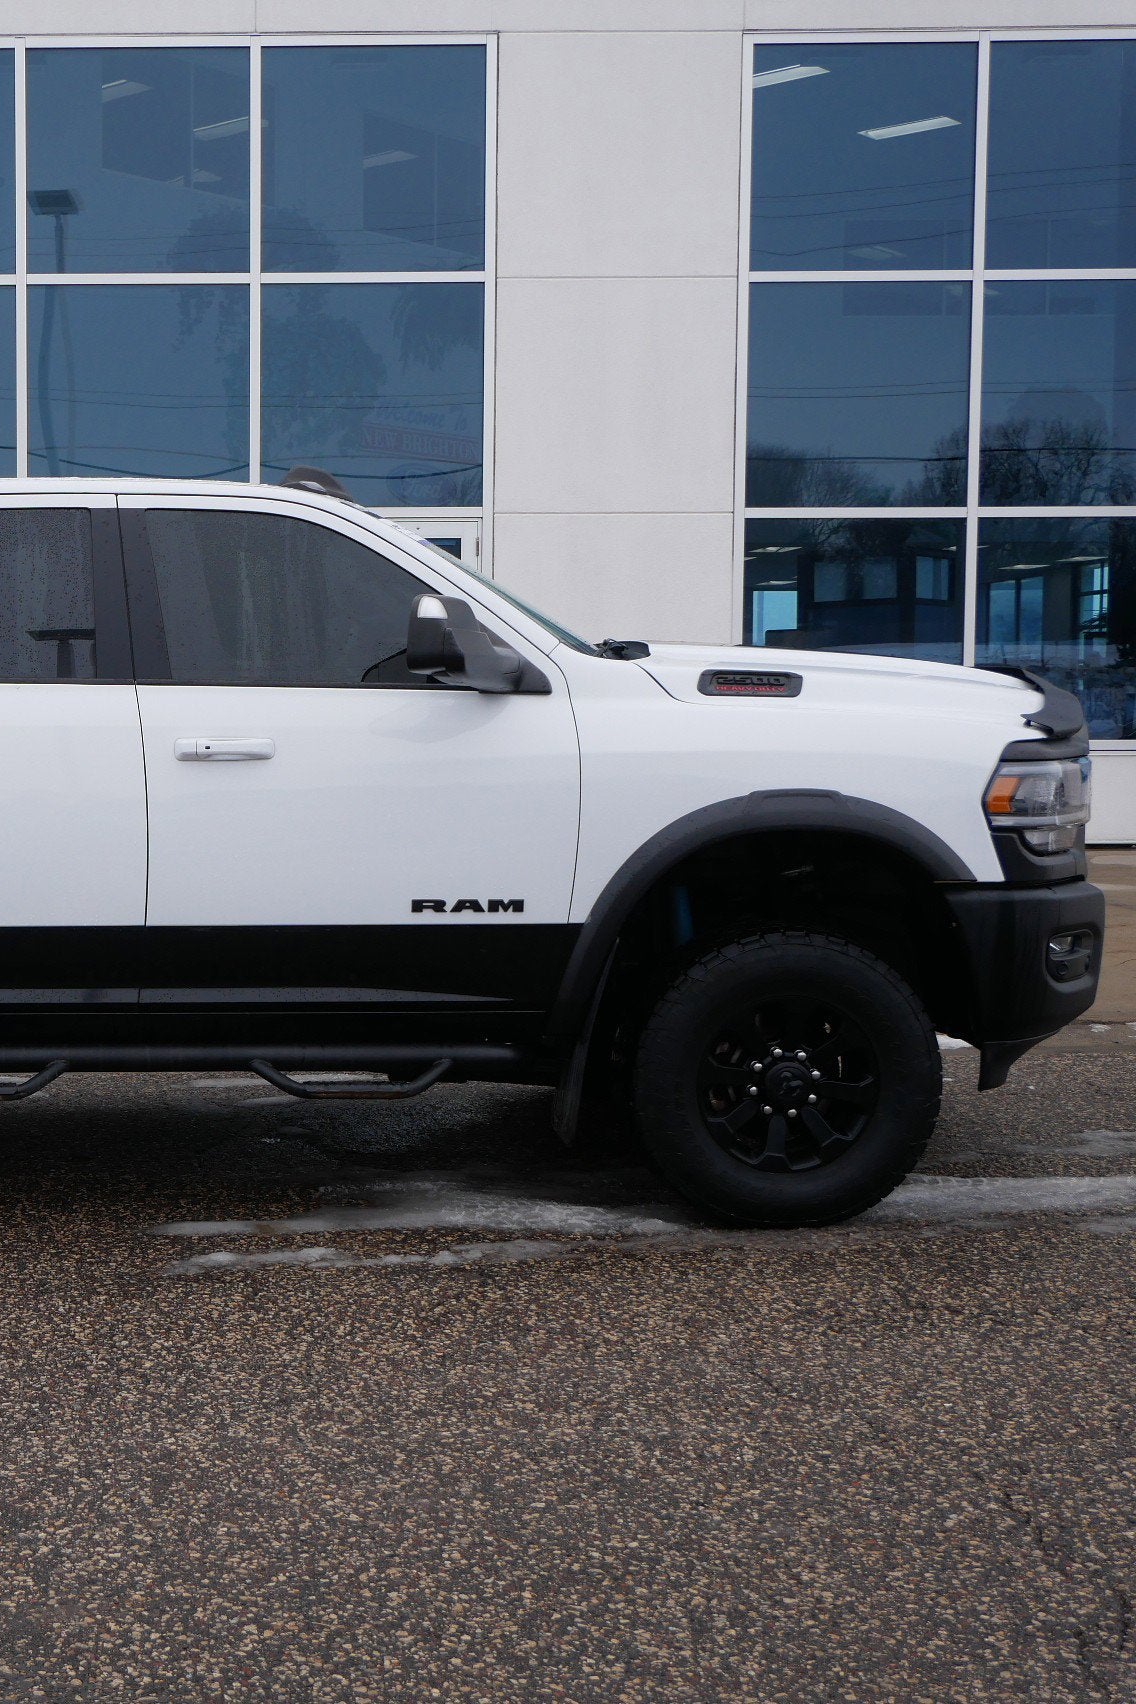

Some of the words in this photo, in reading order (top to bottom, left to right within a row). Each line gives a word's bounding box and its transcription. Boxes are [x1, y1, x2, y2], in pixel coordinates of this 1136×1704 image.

[360, 427, 397, 449] NEW
[402, 434, 478, 459] BRIGHTON
[715, 676, 785, 686] 2500
[411, 899, 524, 912] RAM
